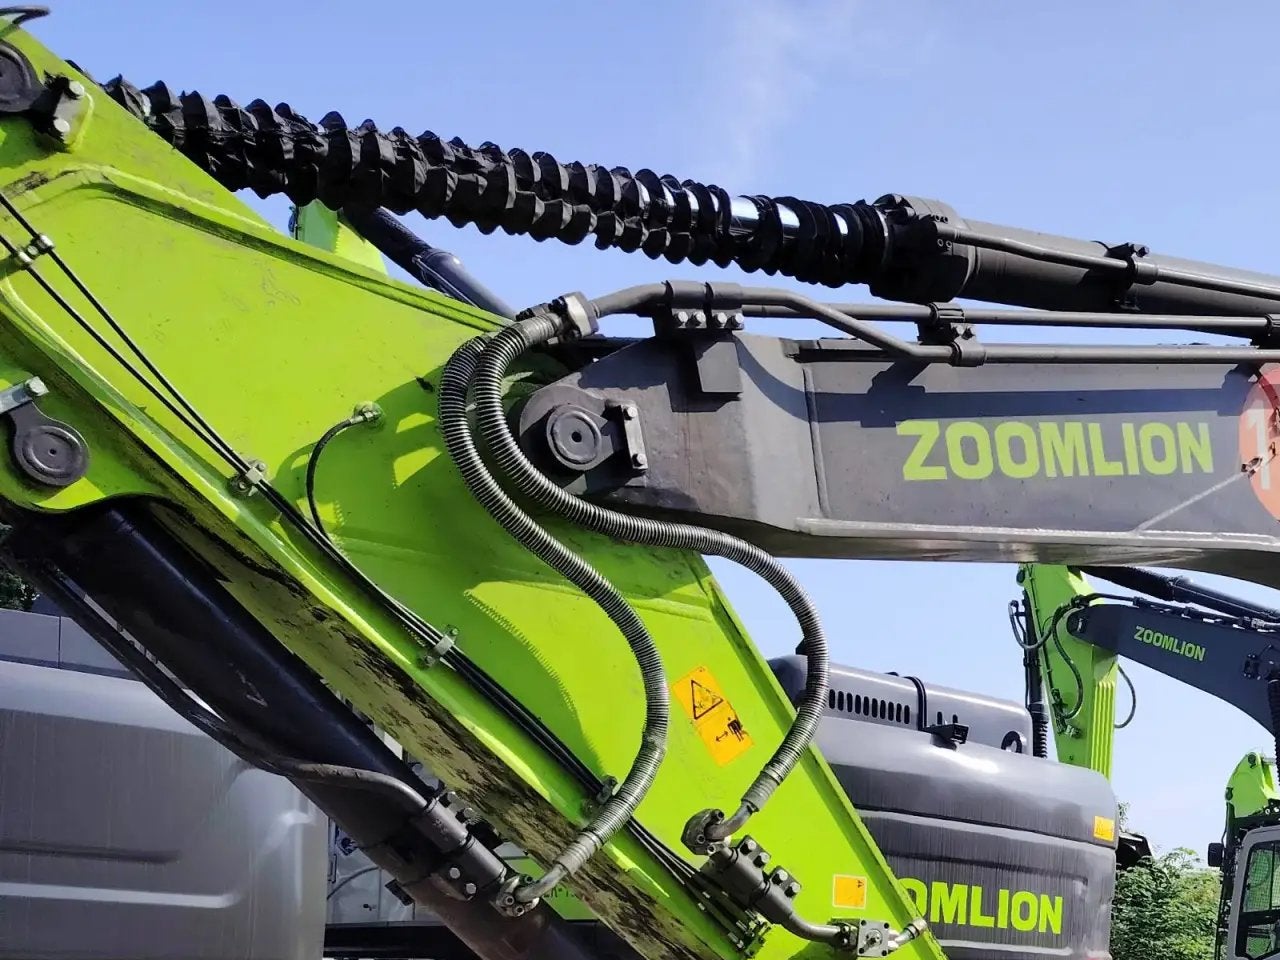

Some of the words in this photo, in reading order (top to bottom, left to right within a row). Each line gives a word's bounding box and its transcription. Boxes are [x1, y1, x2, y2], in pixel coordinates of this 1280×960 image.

[896, 419, 1214, 481] ZOOMLION
[1134, 625, 1206, 662] ZOOMLION
[898, 877, 1064, 935] OMLION
